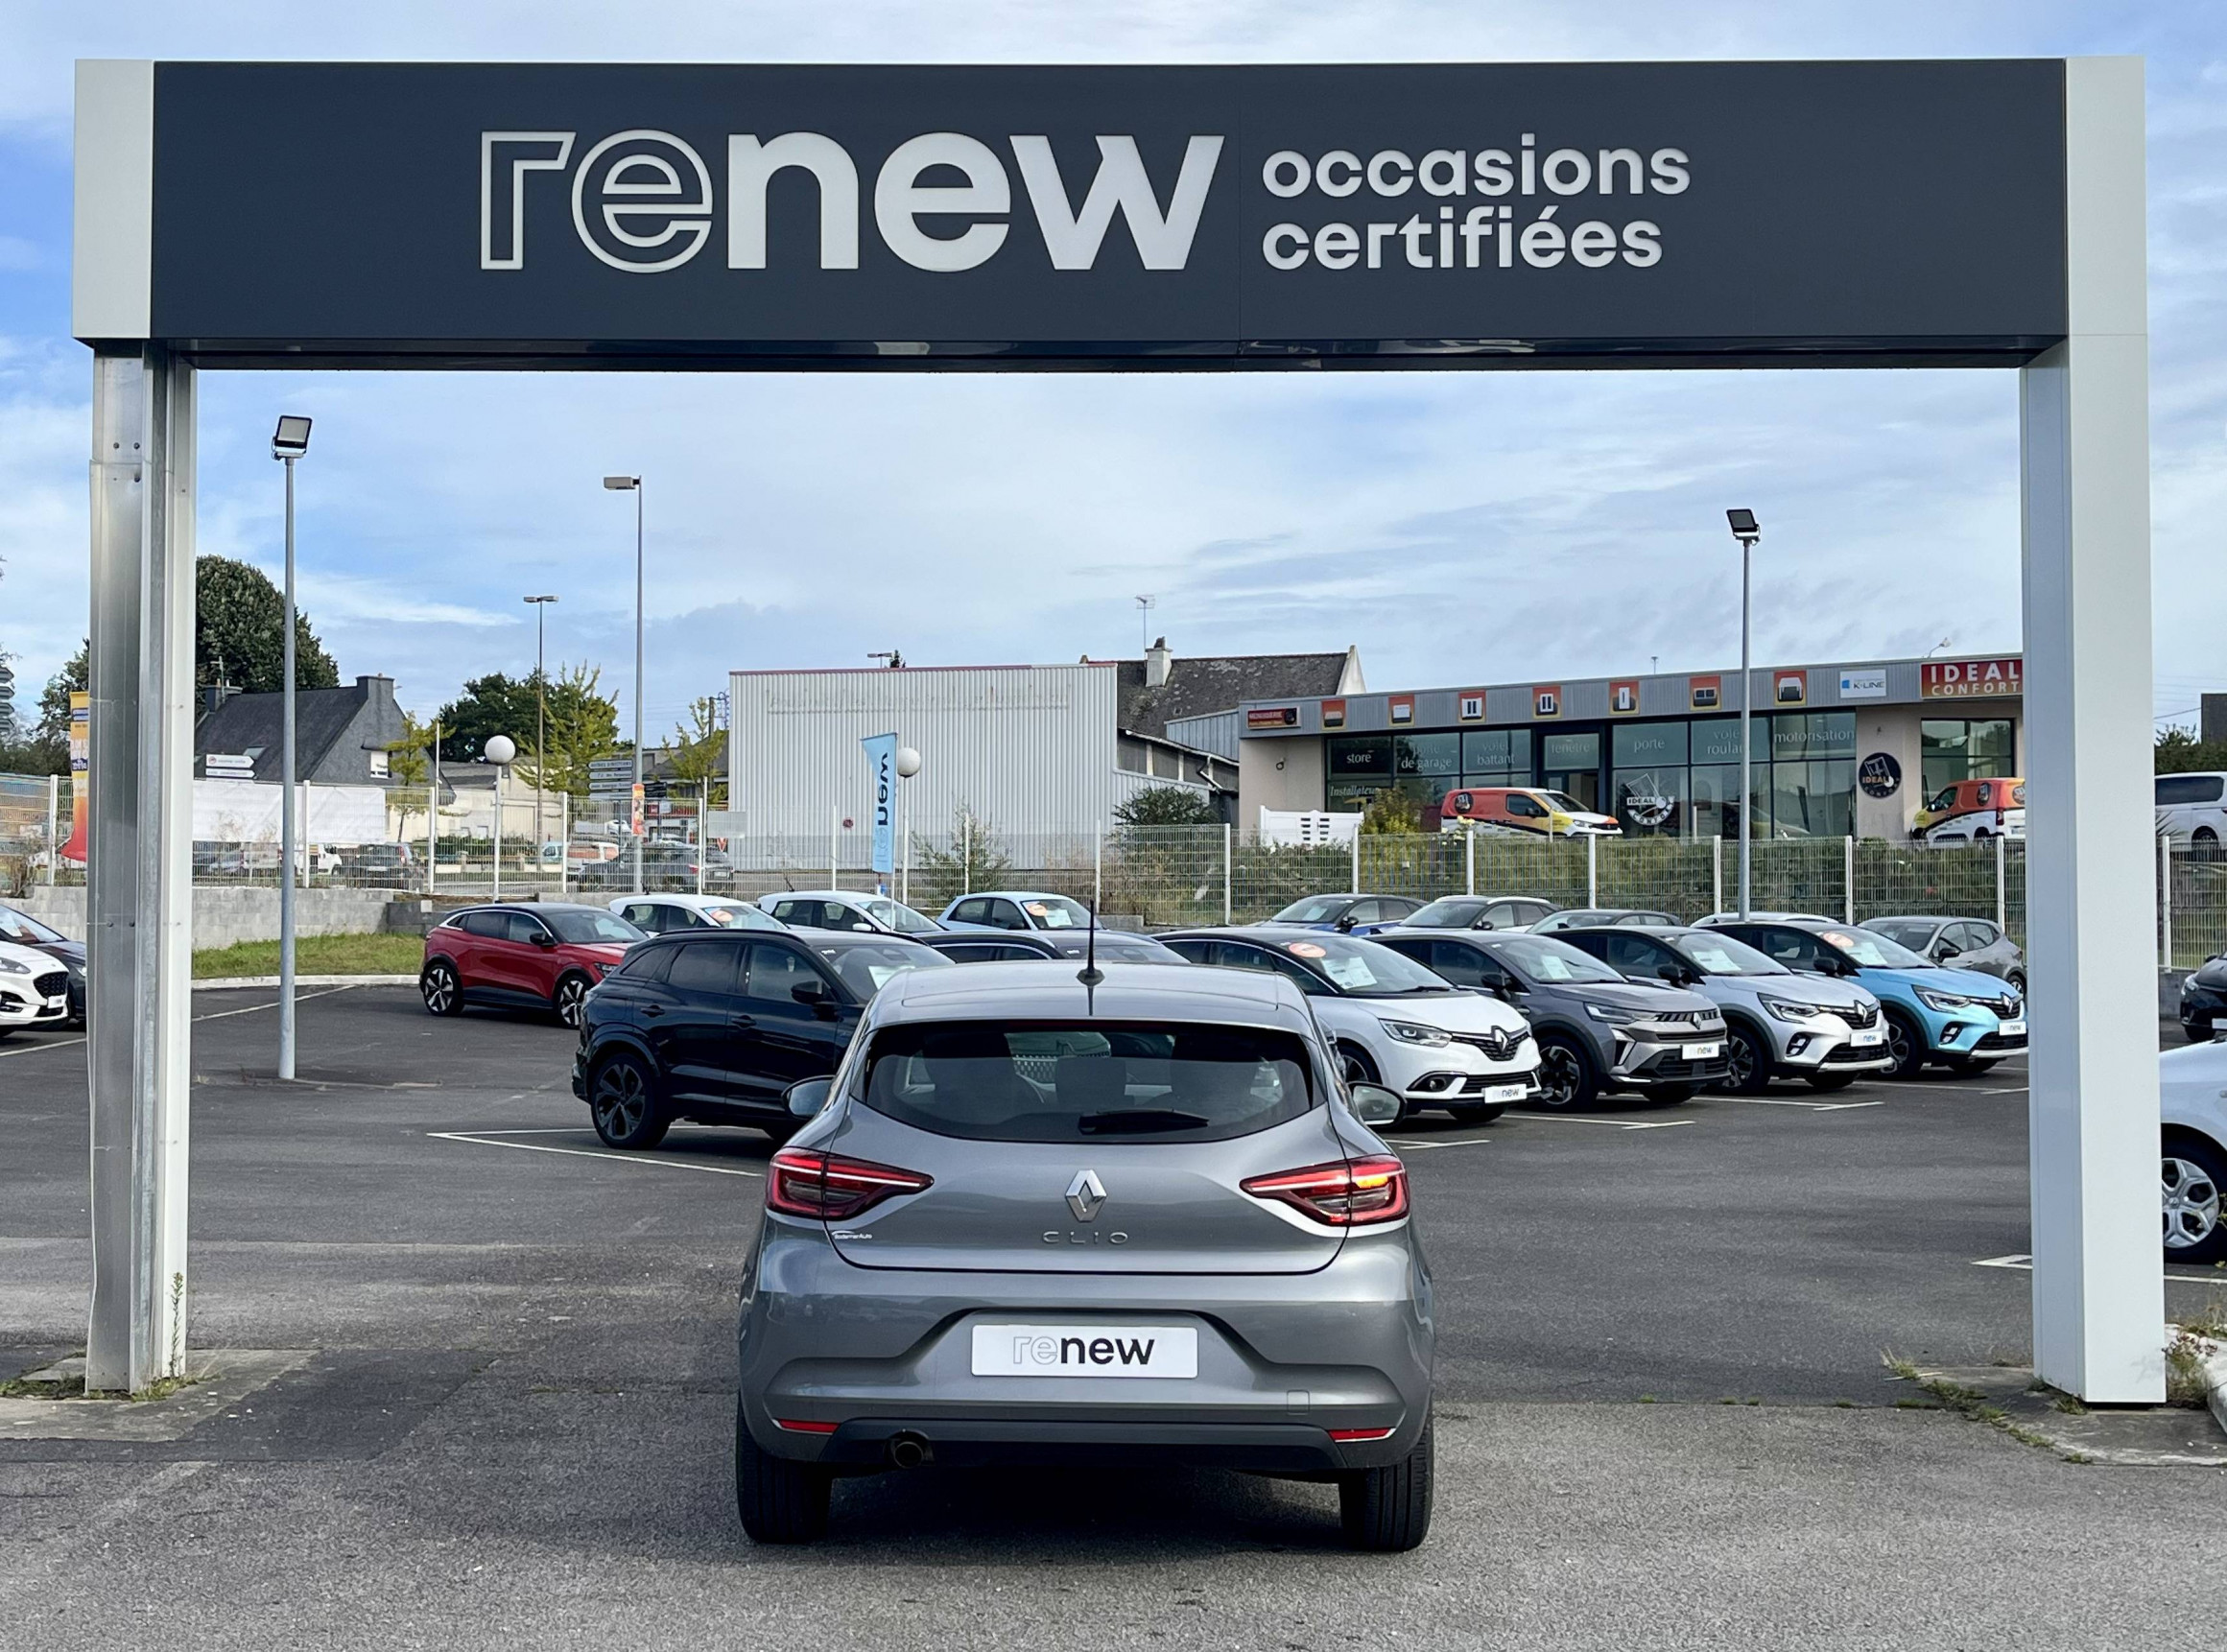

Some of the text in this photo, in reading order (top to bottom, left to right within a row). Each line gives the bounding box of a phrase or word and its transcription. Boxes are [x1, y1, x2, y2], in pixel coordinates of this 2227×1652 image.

[1262, 133, 1691, 198] occasions
[481, 130, 1224, 273] renew
[1262, 205, 1662, 271] certifiées
[1931, 661, 2020, 683] IDEAL
[1931, 681, 2020, 696] CONFORT
[1713, 728, 1741, 739] vole
[1773, 729, 1855, 743] motorisation
[1634, 738, 1666, 753] porte
[1707, 741, 1742, 755] roula
[1346, 752, 1372, 765] store
[1401, 756, 1453, 772] de garage
[1477, 754, 1516, 766] battant
[1862, 775, 1887, 784] IDEAL
[1330, 785, 1376, 797] Installateu
[1043, 1231, 1128, 1244] CLIO
[1012, 1335, 1155, 1366] renew
